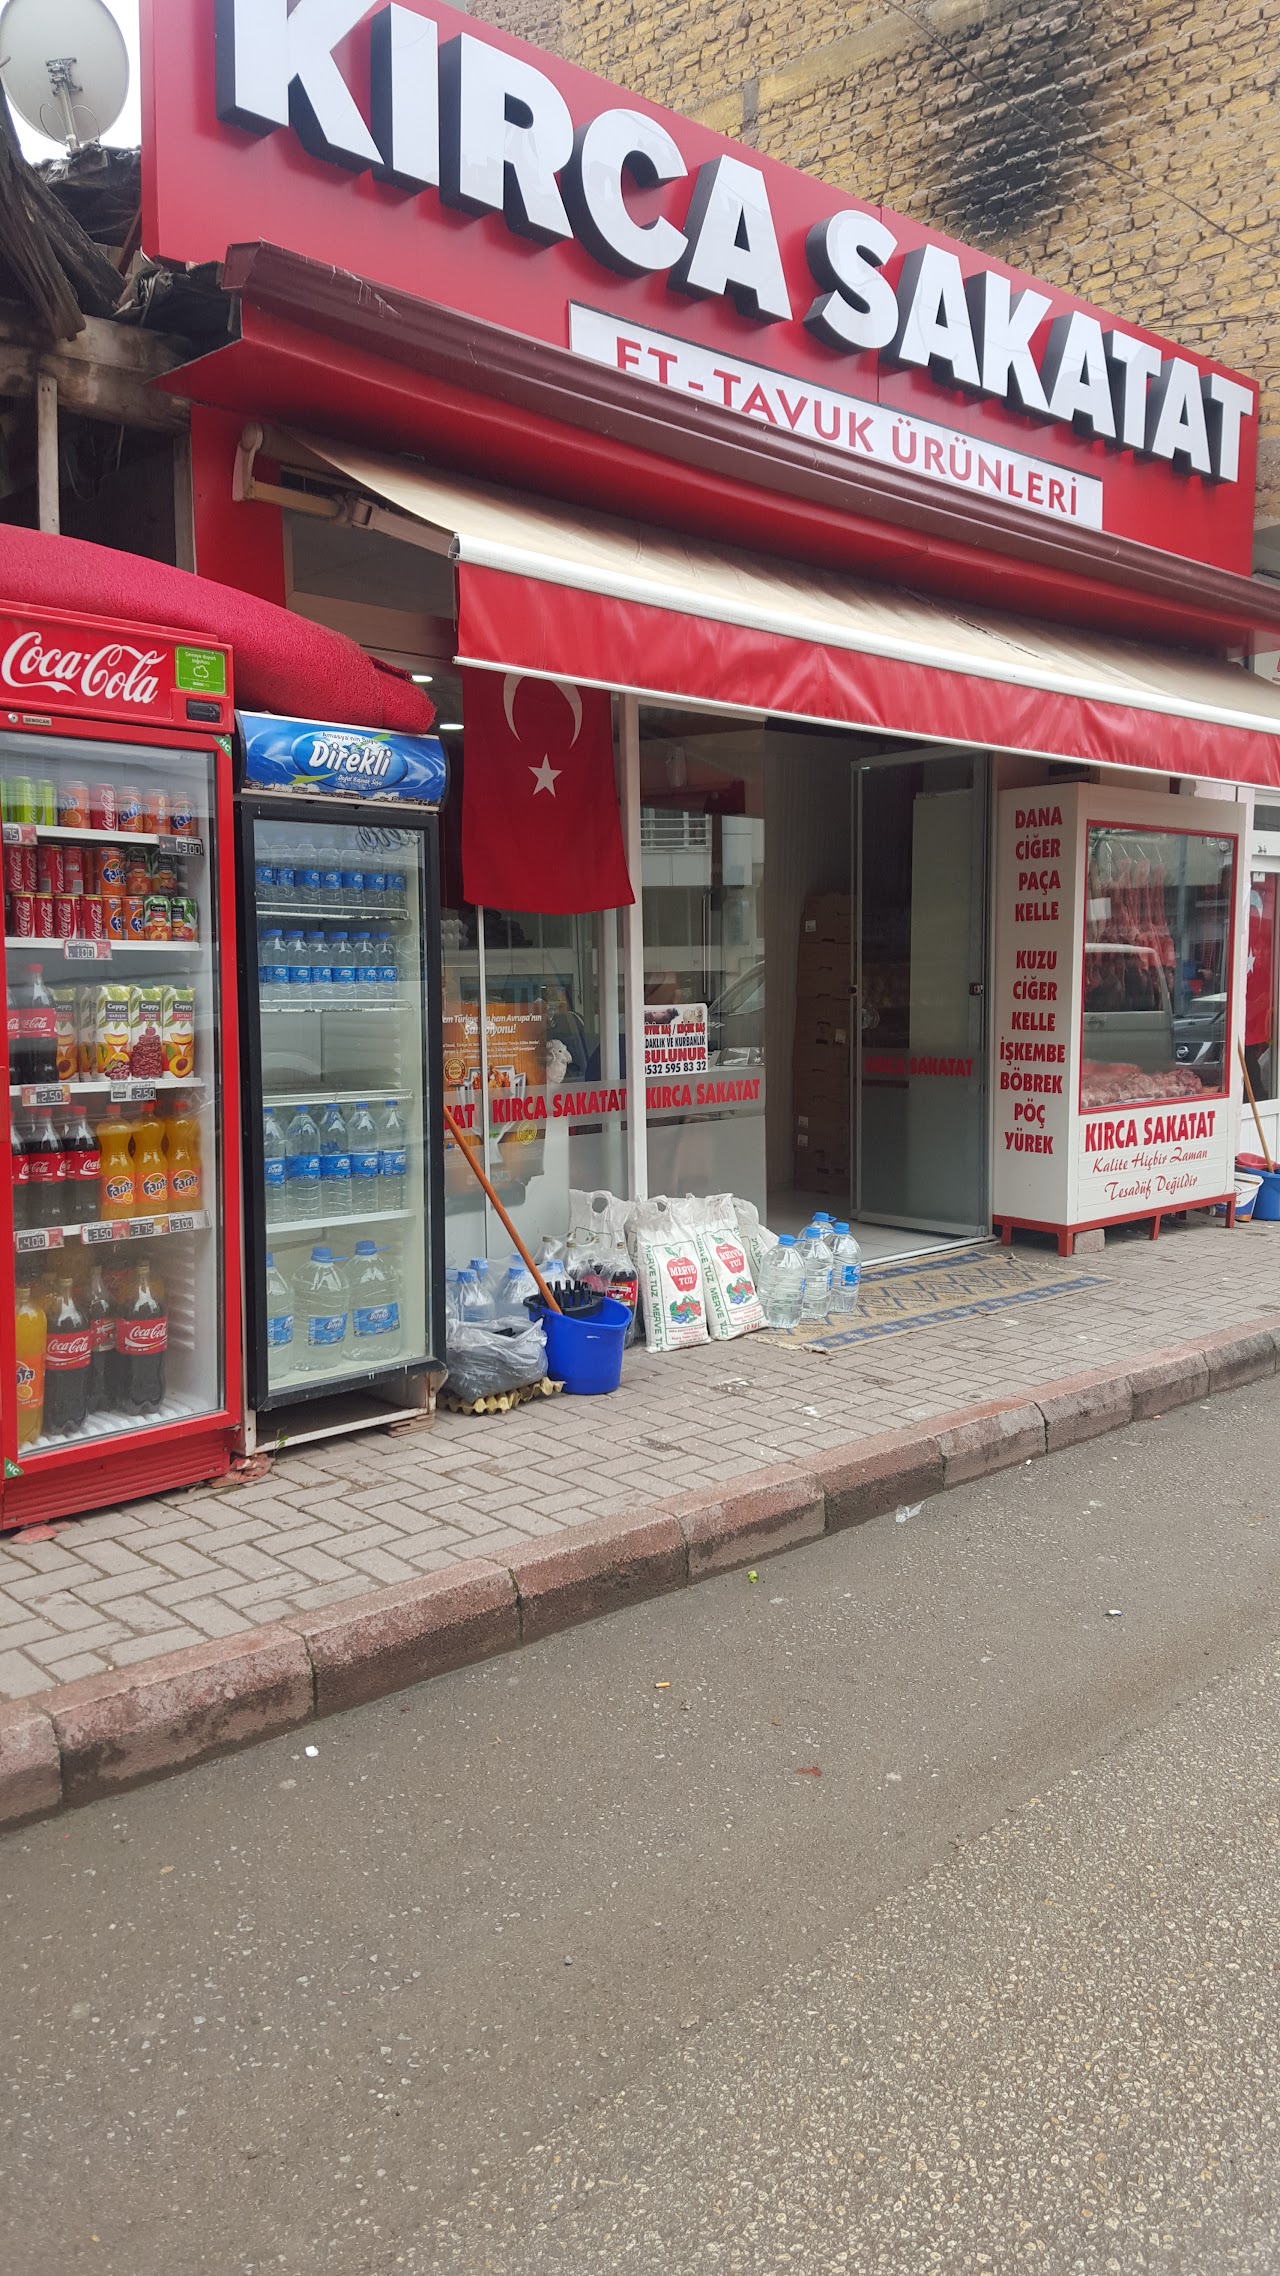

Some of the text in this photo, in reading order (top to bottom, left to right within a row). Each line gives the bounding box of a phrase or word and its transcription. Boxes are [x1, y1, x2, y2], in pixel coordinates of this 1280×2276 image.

[222, 0, 1253, 485] KIRCA SAKATAT
[891, 417, 1078, 516] ÜRÜNLERİ
[1, 631, 168, 704] Coca-Cola
[308, 740, 392, 777] Direkli
[1015, 806, 1063, 829] DANA
[1015, 833, 1061, 860] CİĞER
[1018, 870, 1061, 896] PAÇA
[1015, 902, 1059, 922] KELLE
[1016, 950, 1057, 970] KUZU
[1012, 975, 1058, 1001] CİĞER
[107, 1003, 127, 1011] Cappy
[140, 1003, 160, 1011] Cappy
[174, 1003, 192, 1011] Cappy
[1011, 1011, 1056, 1032] KELLE
[645, 1035, 706, 1049] DAKLIK VE KURBANLIK
[1000, 1035, 1066, 1066] İŞKEMBE
[644, 1047, 706, 1064] BULUNUR
[644, 1060, 707, 1075] 532 595 83 32
[1000, 1067, 1063, 1094] BÖBREK
[492, 1088, 628, 1124] KIRCA SAKATAT
[646, 1078, 761, 1110] KIRCA SAKATAT
[1014, 1098, 1046, 1129] PÖÇ
[1005, 1127, 1054, 1155] YÜREK
[1085, 1110, 1216, 1153] KIRCA SAKATAT
[1092, 1146, 1208, 1174] Kalite Hiçbir Zaman
[1104, 1173, 1198, 1201] Tesadüf Değildir
[645, 1244, 657, 1277] MERVE
[720, 1248, 743, 1261] MERVE
[729, 1259, 742, 1268] TUZ
[669, 1264, 697, 1277] MERVE
[678, 1276, 694, 1285] TUZ
[650, 1280, 659, 1298] TUZ
[703, 1265, 714, 1283] TUZ
[710, 1287, 725, 1319] MERVE
[129, 1321, 167, 1341] Coca-Cola
[652, 1302, 663, 1335] MERVE
[47, 1336, 89, 1354] Coca-Cola
